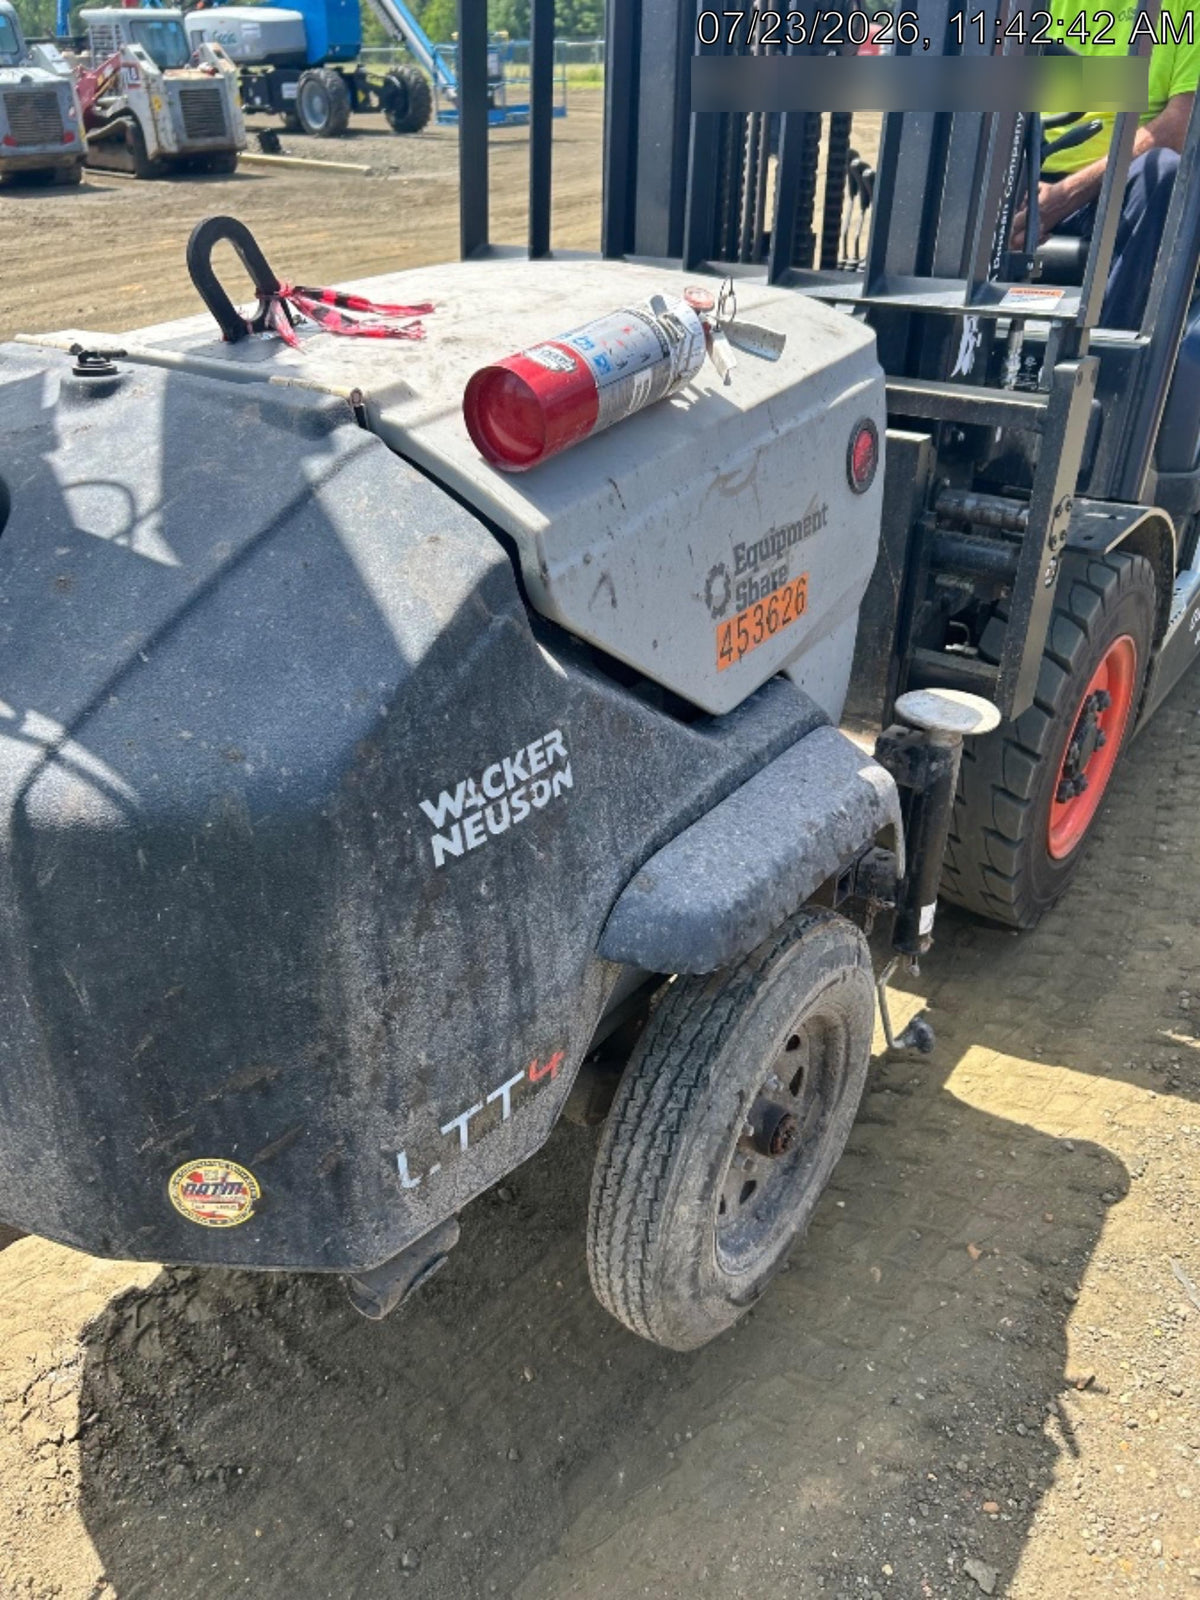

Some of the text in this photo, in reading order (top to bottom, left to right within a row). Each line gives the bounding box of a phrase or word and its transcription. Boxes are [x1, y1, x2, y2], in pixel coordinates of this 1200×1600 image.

[1005, 111, 1025, 198] Company
[732, 502, 829, 577] Equipment
[719, 577, 807, 663] 453626
[735, 563, 790, 613] Share
[418, 729, 568, 829] WACKER
[431, 761, 574, 869] NEUSON
